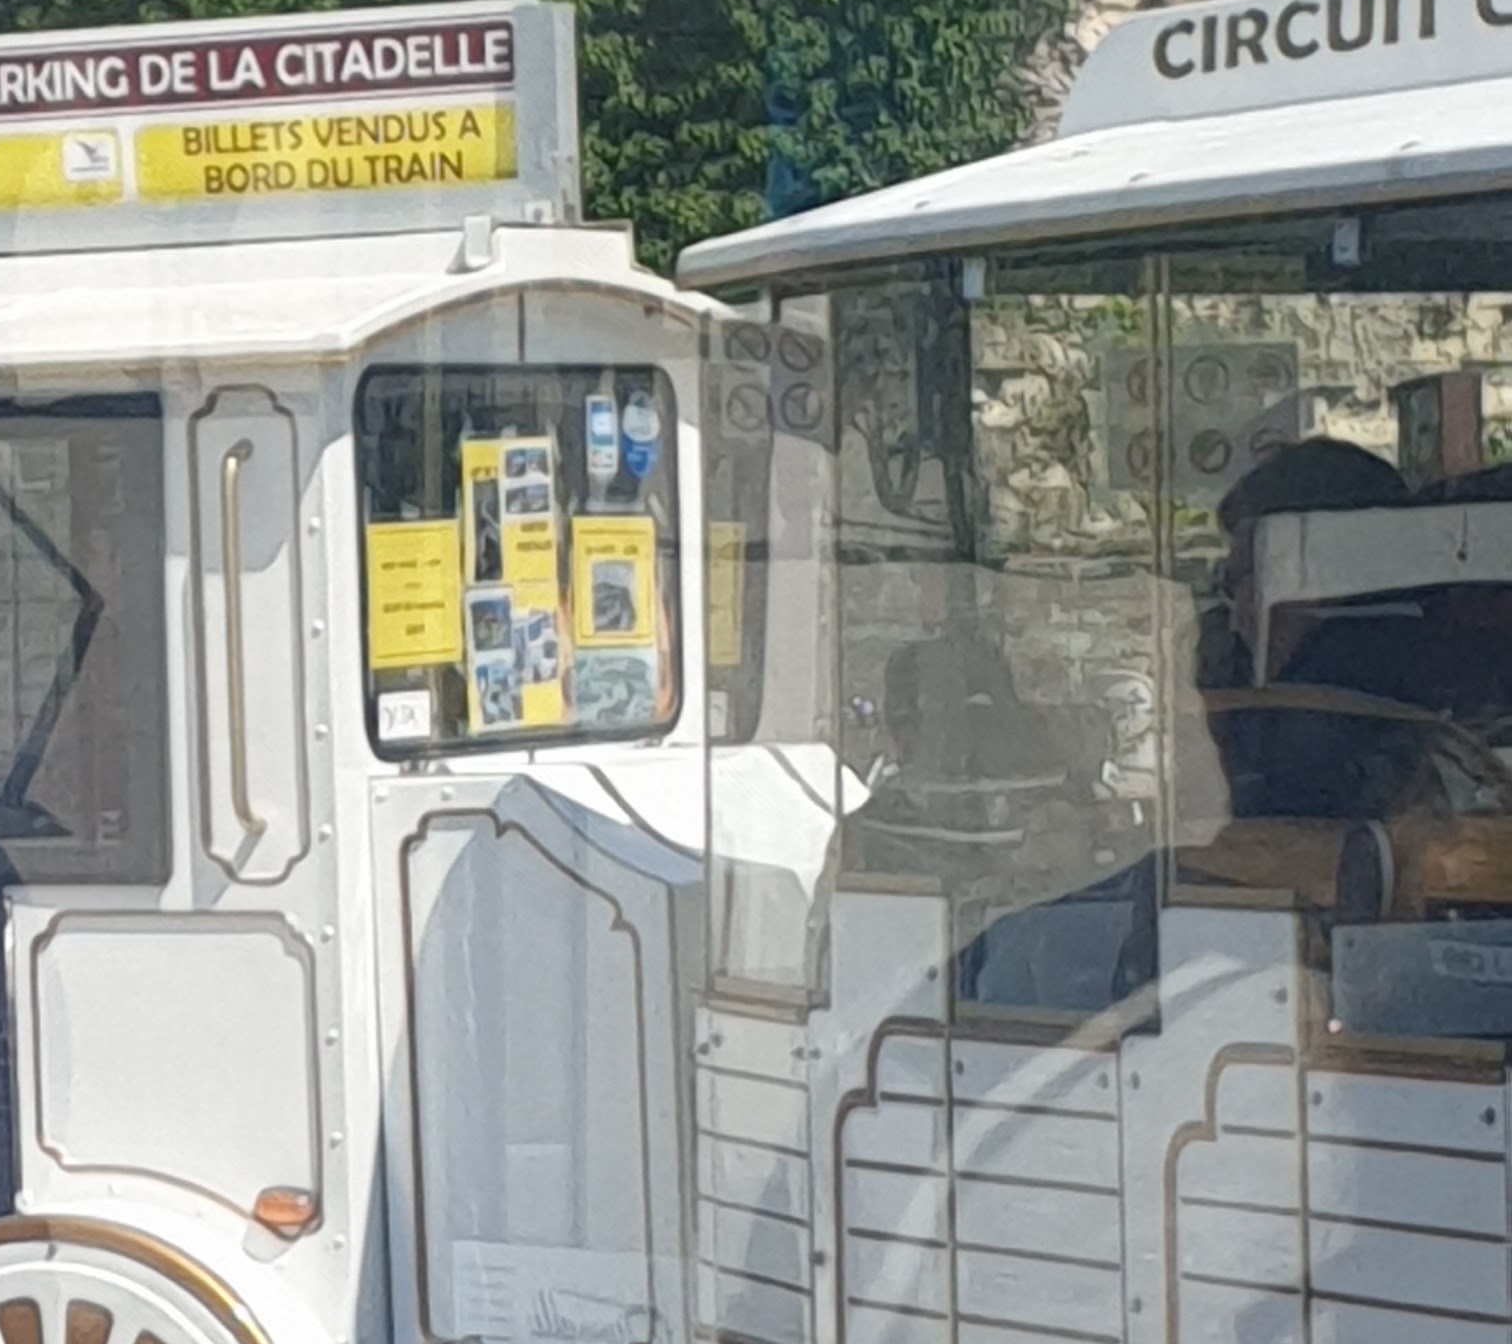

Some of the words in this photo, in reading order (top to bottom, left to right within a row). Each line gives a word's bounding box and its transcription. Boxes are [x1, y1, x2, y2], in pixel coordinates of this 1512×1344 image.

[139, 52, 199, 97] DE
[207, 46, 267, 92] LA
[275, 30, 512, 87] CITADELLE
[183, 120, 303, 157] BILLETS
[311, 111, 447, 146] VENDUS
[204, 161, 297, 196] BORD
[307, 155, 356, 188] DU
[367, 150, 465, 187] TRAIN
